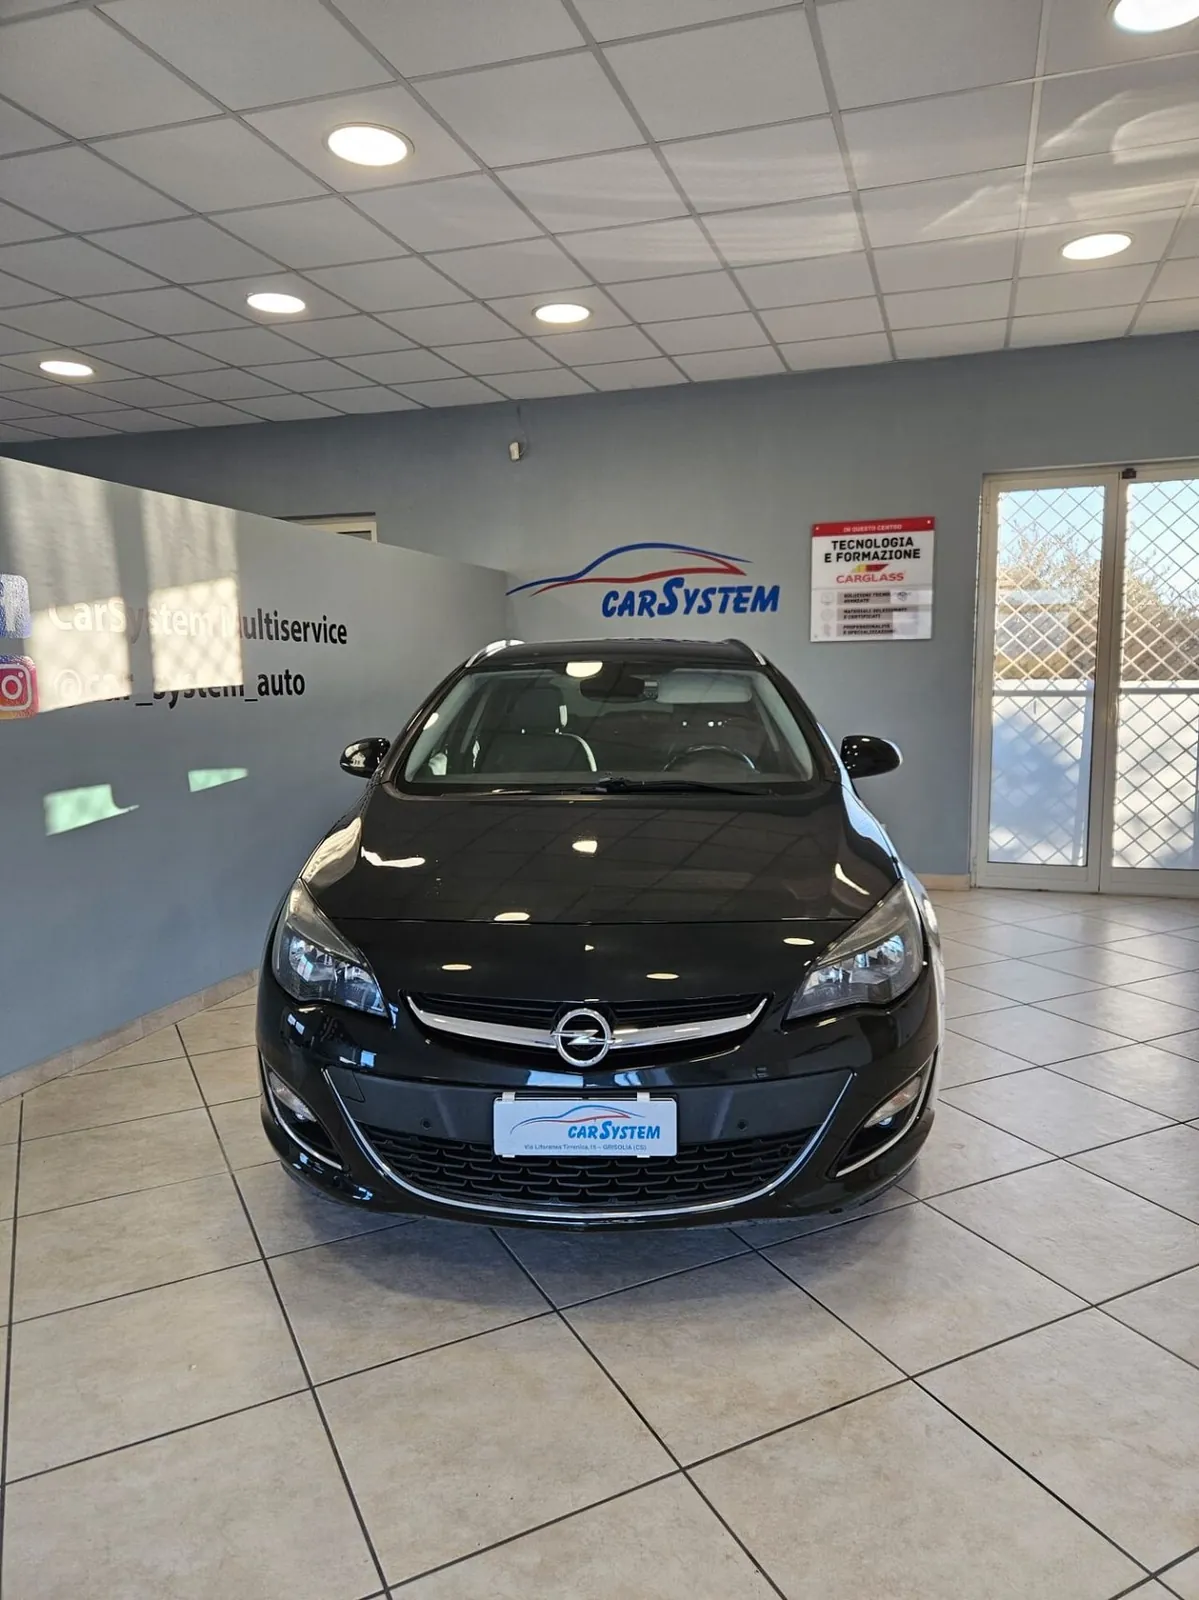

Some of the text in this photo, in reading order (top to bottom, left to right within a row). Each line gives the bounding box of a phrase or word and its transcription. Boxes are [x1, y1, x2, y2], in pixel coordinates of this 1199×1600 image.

[831, 536, 914, 551] TECNOLOGIA
[824, 548, 921, 563] E FORMAZIONE
[836, 572, 905, 584] CARGLASS
